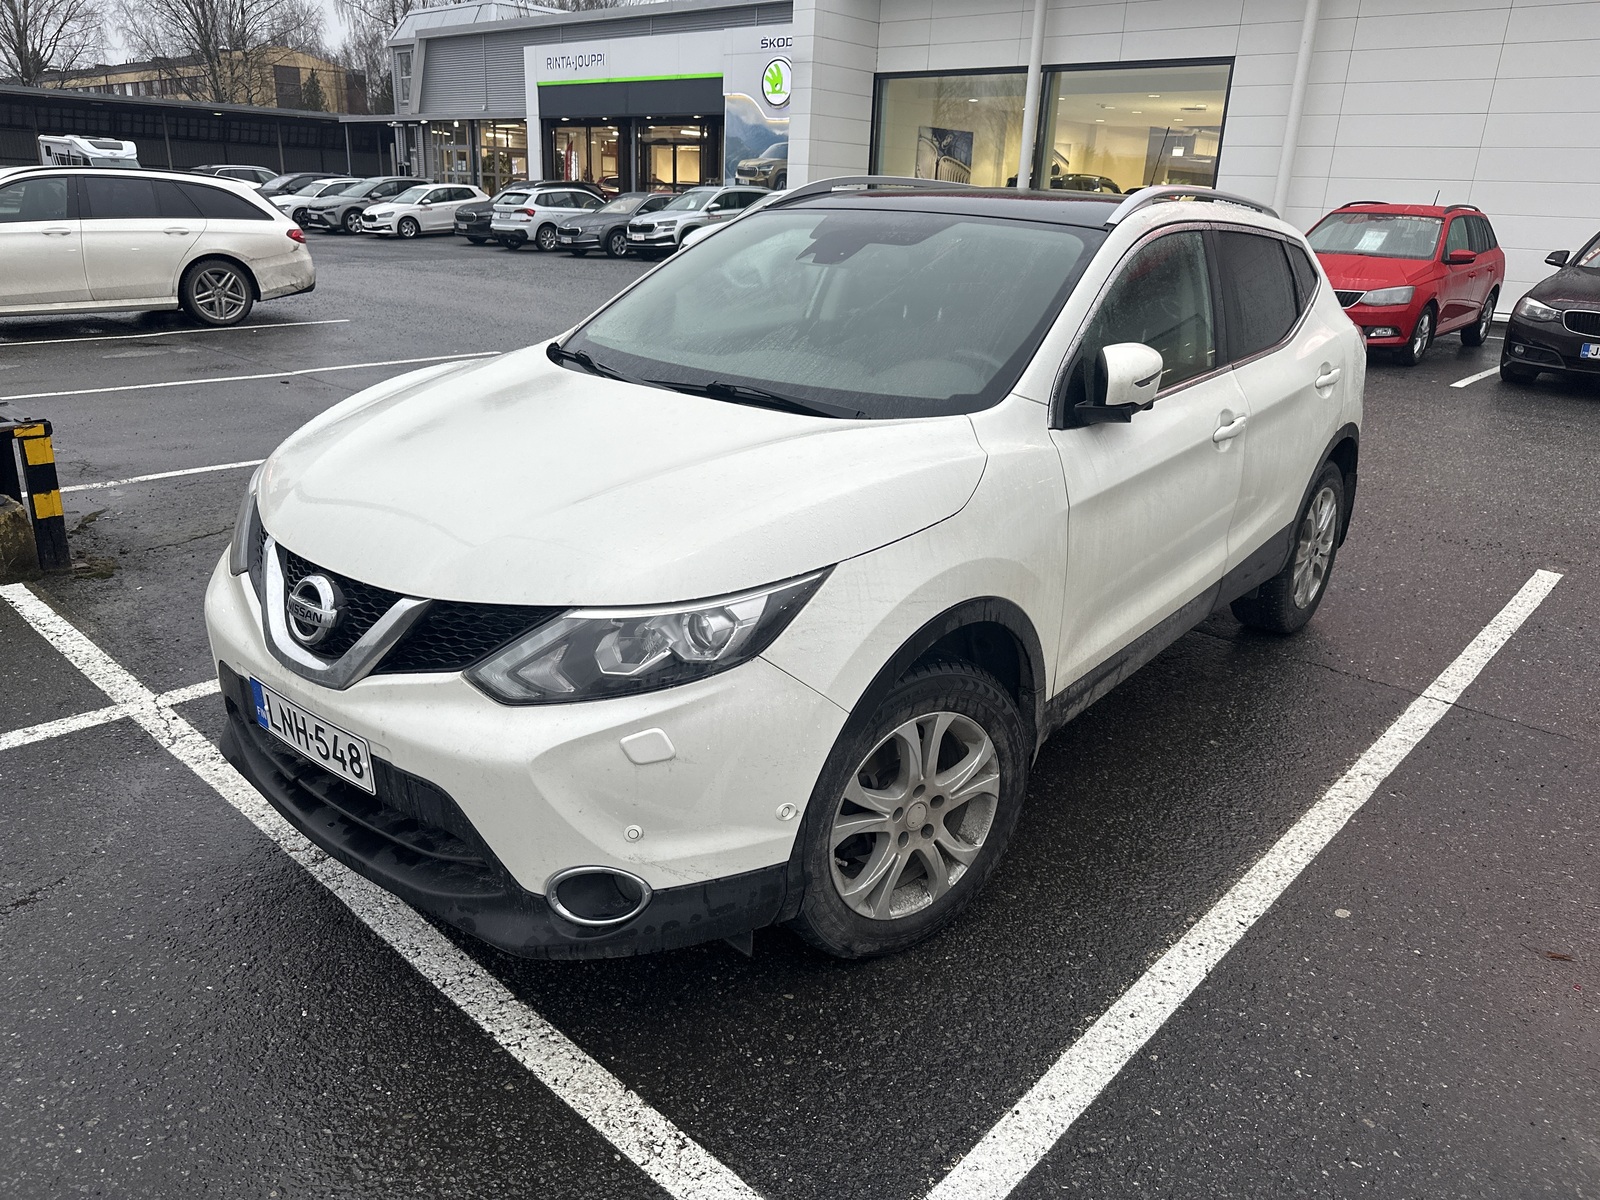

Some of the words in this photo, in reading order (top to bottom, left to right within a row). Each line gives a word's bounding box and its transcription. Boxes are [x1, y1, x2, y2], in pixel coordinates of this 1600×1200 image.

[546, 53, 605, 71] RINTA-JOUPPI
[290, 602, 323, 624] NISSAN
[265, 693, 365, 780] LNH-548
